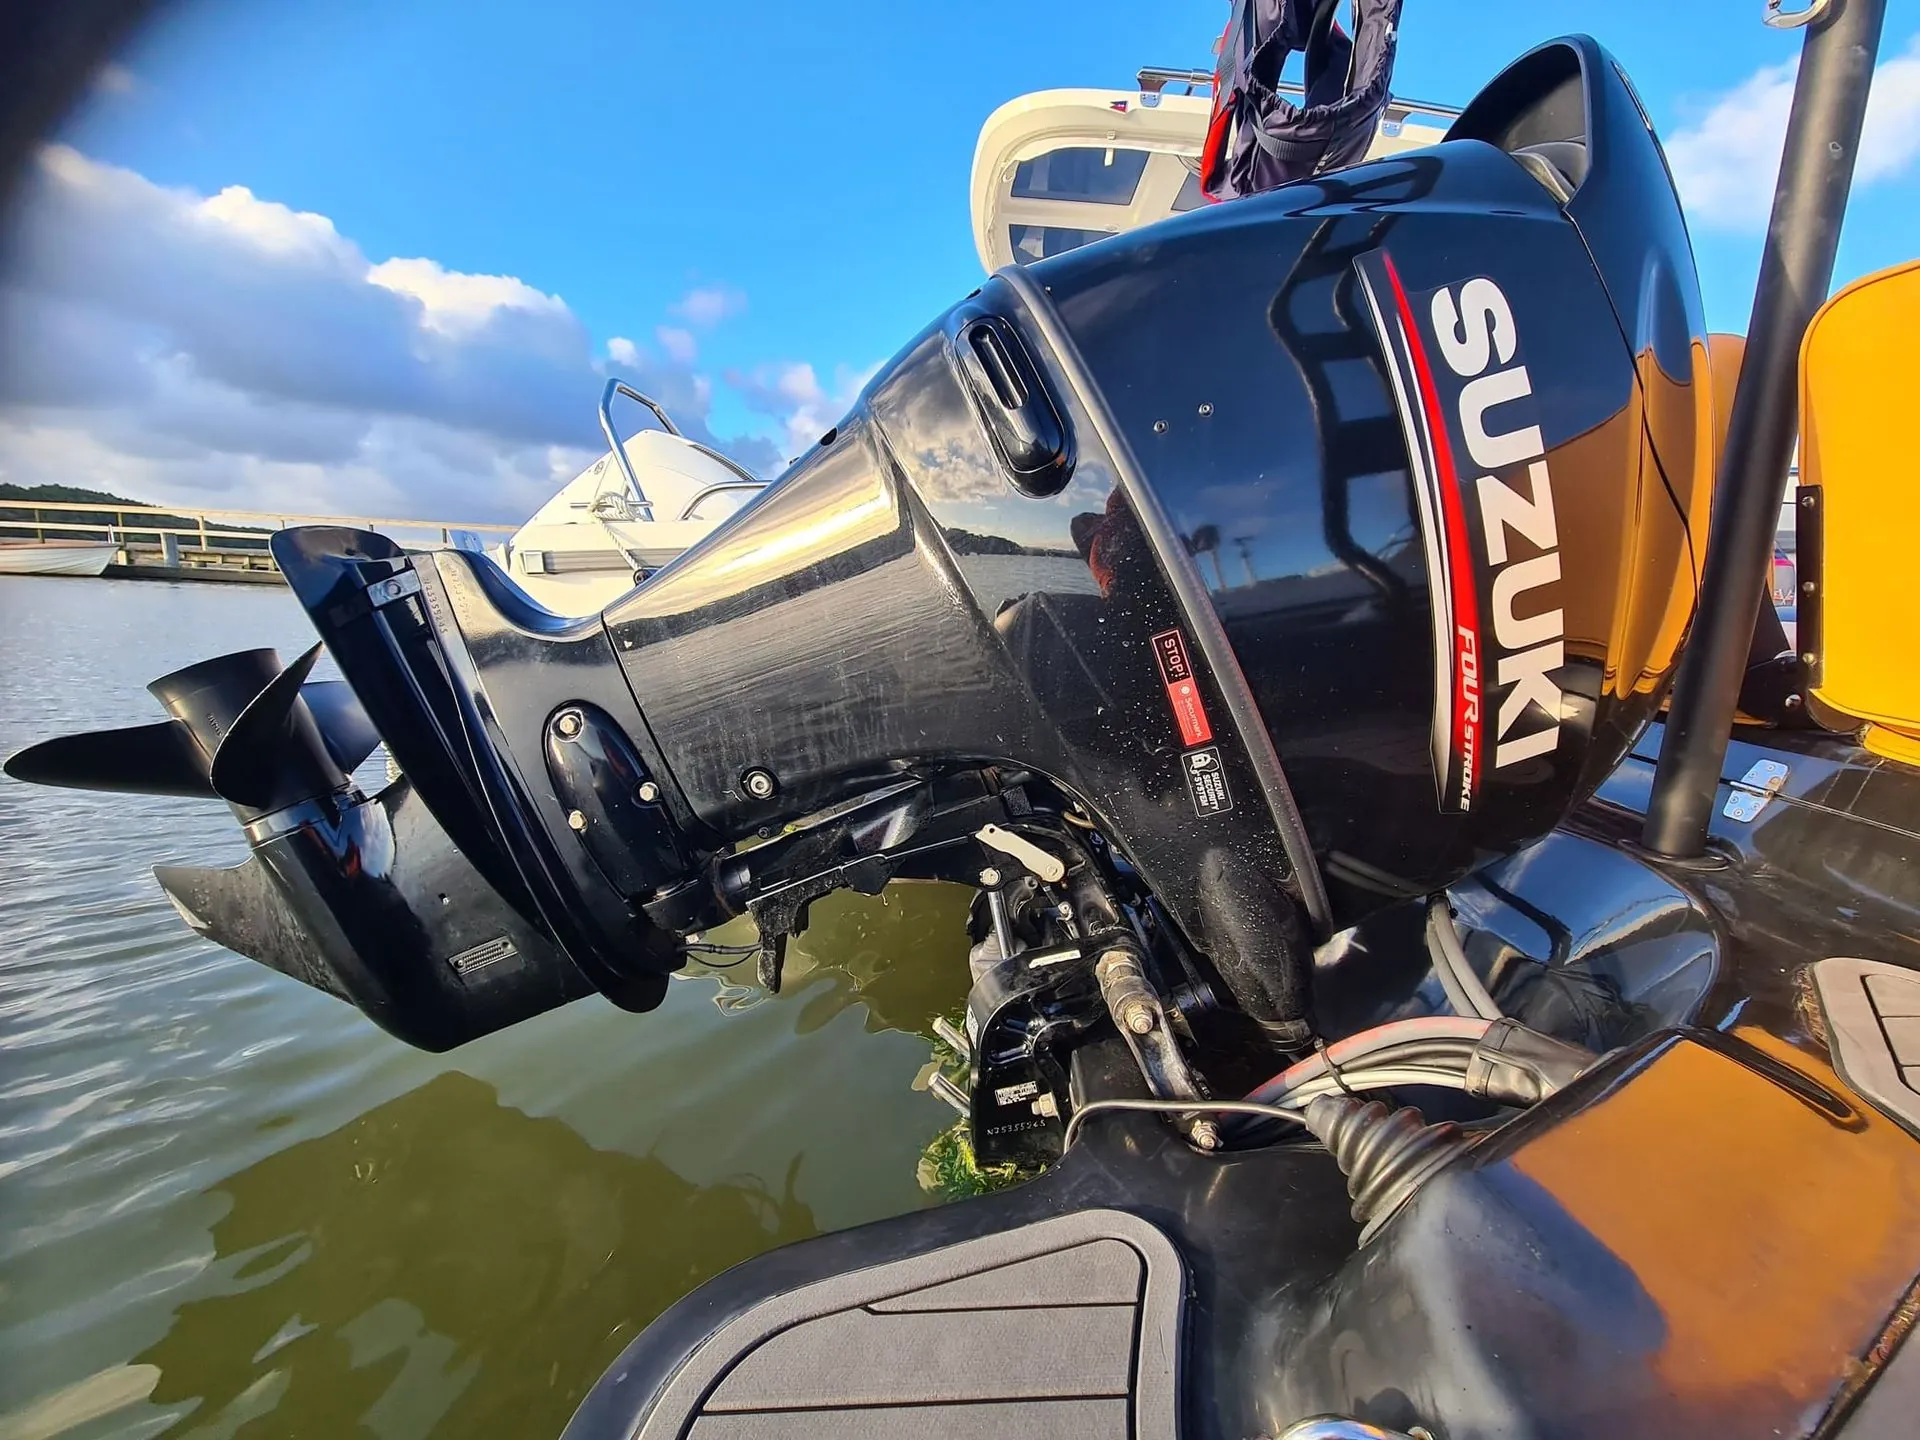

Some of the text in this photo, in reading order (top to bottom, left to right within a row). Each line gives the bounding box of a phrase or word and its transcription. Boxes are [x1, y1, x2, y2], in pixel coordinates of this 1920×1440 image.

[1430, 277, 1565, 769] SUZUKI
[1164, 638, 1186, 677] STOP!
[1457, 624, 1479, 812] FOUR STROKE
[1194, 776, 1210, 807] SYSTEM
[1202, 774, 1220, 811] SECURITY
[1210, 771, 1226, 801] SUZUKI
